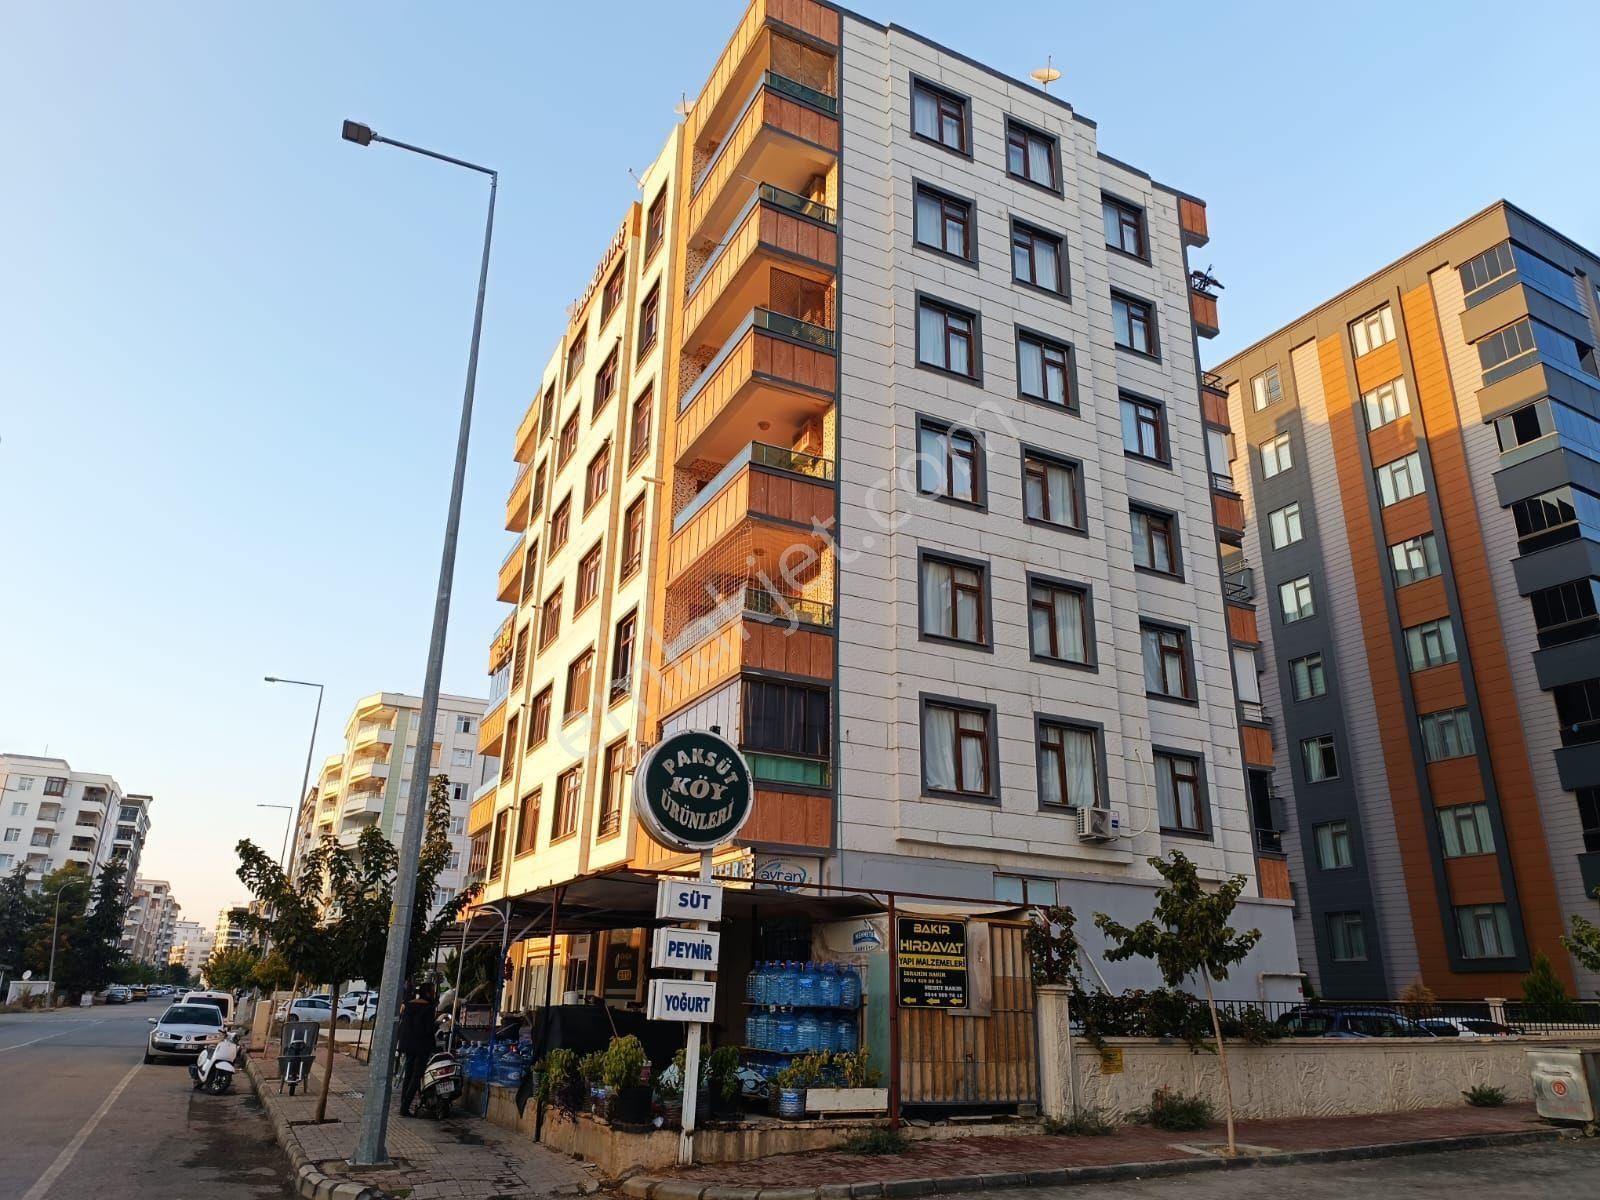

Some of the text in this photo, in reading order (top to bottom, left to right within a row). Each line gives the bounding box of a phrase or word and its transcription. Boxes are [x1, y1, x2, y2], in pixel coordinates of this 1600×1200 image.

[661, 747, 740, 784] PAKSÜT
[669, 774, 729, 800] KÖY
[660, 787, 736, 830] ÜRÜNLERİ
[761, 870, 802, 883] ayran
[678, 889, 712, 910] SÜT
[913, 923, 951, 935] BAKIR
[667, 938, 713, 961] PEYNİR
[900, 939, 964, 954] HIRDAVAT
[899, 957, 966, 968] YAPI MALZEMELERİ
[664, 992, 711, 1013] YOĞURT
